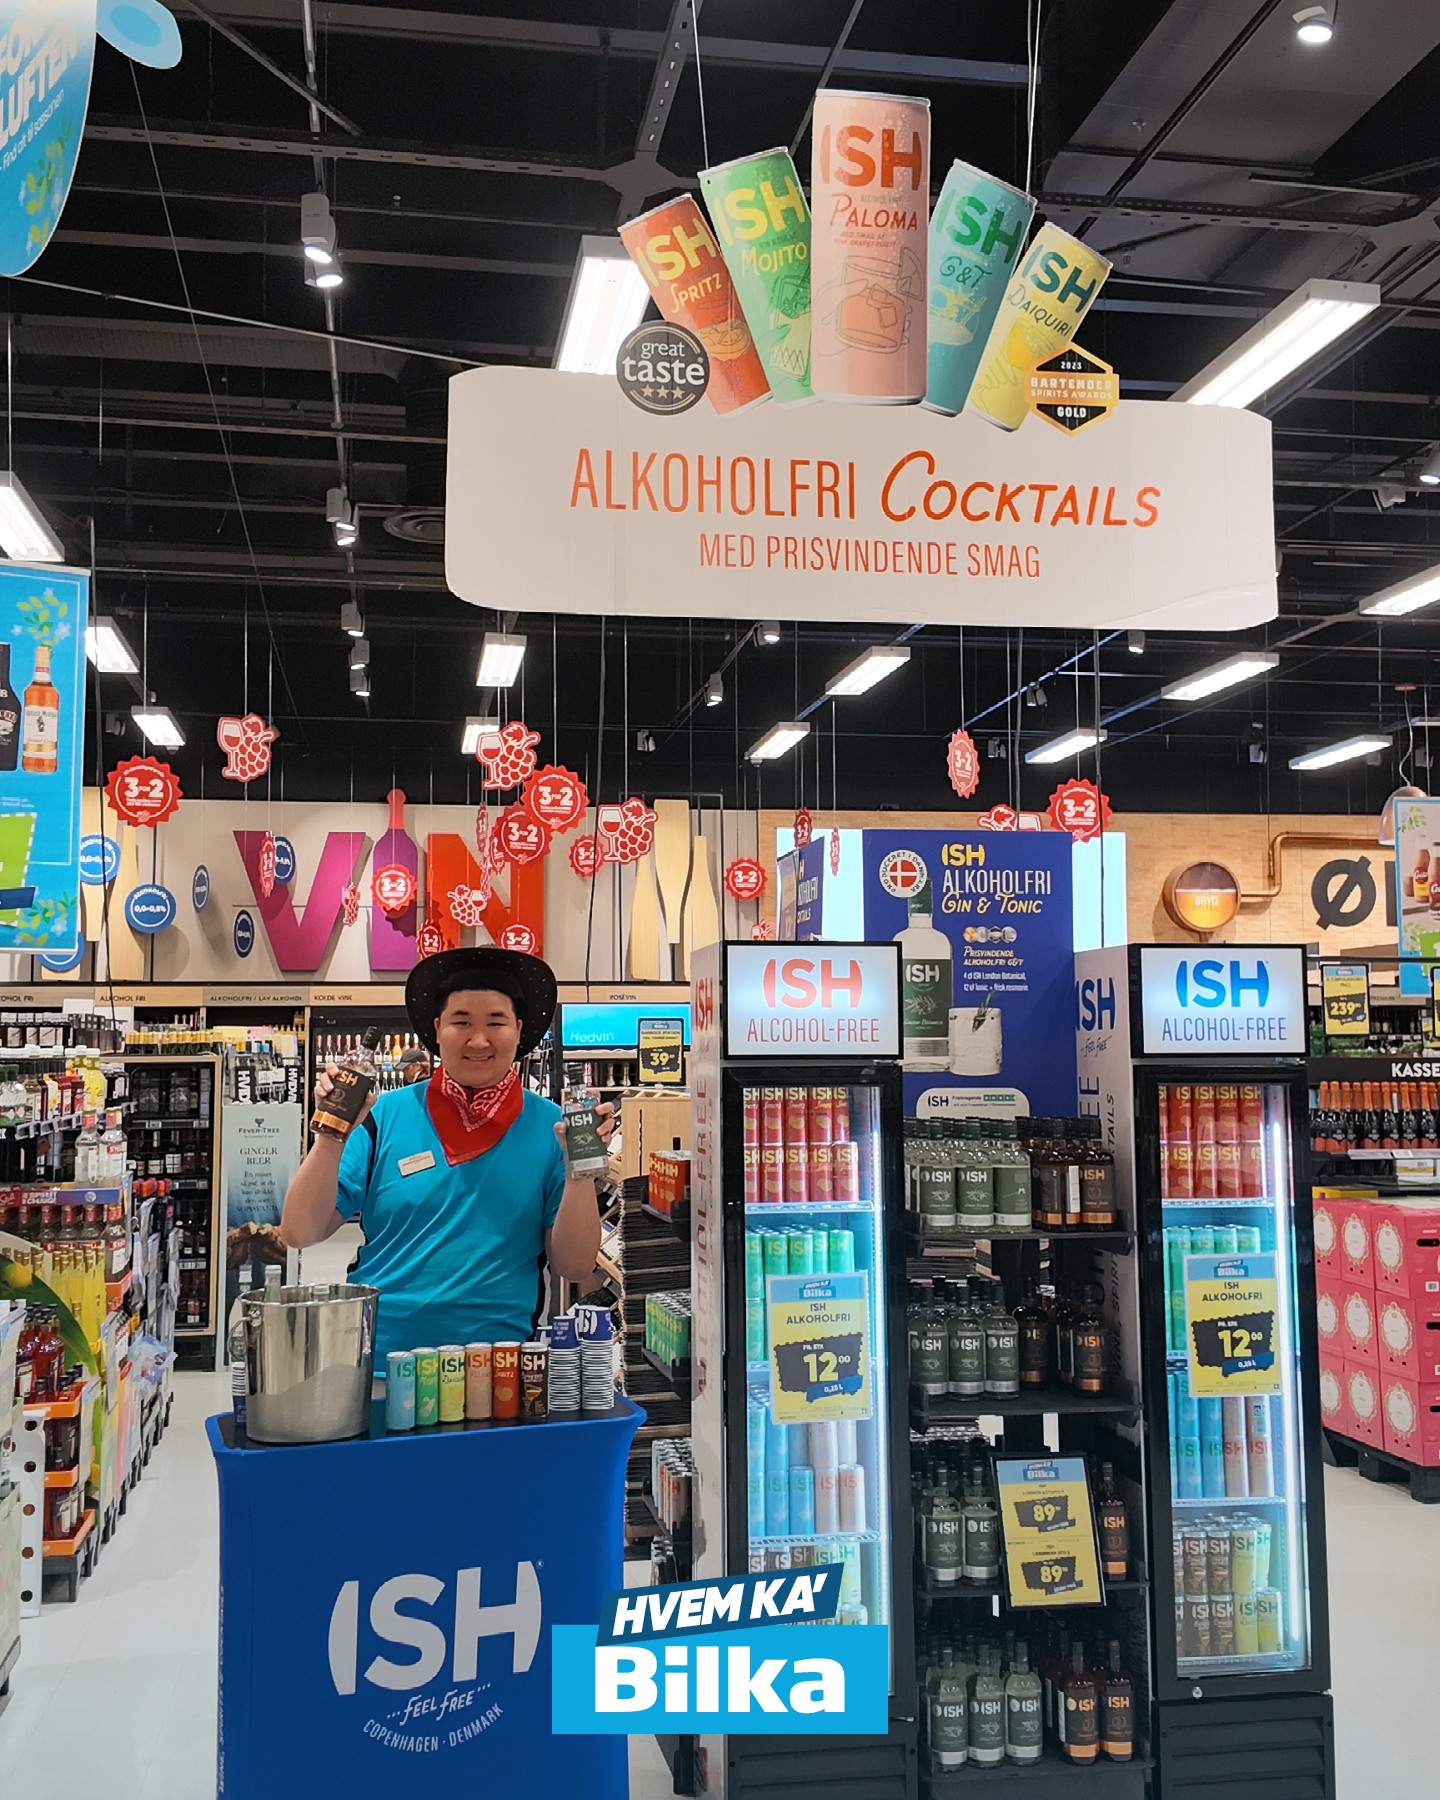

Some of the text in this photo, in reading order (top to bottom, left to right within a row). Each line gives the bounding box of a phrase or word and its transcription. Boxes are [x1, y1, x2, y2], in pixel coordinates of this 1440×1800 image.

[820, 125, 923, 190] ISH
[714, 175, 806, 246] ISH
[830, 193, 918, 230] PALOMA
[935, 189, 1023, 264] ISH
[636, 217, 716, 288] ISH
[741, 242, 807, 277] MOJITO
[939, 256, 993, 289] G&T
[1021, 244, 1099, 313] ISH
[670, 273, 722, 313] SPRITZ
[1006, 283, 1073, 337] DAIQUIRI
[641, 341, 685, 359] great
[622, 356, 705, 385] taste
[1060, 361, 1082, 370] 2023
[1030, 377, 1112, 390] BARTENDER
[1030, 388, 1112, 400] SPIRITS AWARDS
[1057, 406, 1087, 418] GOLD
[570, 448, 1162, 528] ALKOHOLFRI COCKTAILS
[699, 532, 1041, 578] MED PRISVINDENDE SMAG
[941, 843, 985, 867] ISH
[942, 869, 1051, 895] ALKOHOLFRI
[942, 890, 1043, 914] GIN & TONIC
[906, 964, 940, 983] ISH
[763, 958, 863, 1008] ISH
[1175, 960, 1270, 1008] ISH
[696, 977, 713, 1031] ISH
[1330, 1001, 1355, 1015] 239
[747, 1018, 880, 1043] ALCOHOL-FREE
[1161, 1017, 1287, 1041] ALCOHOL-FREE
[650, 1052, 670, 1066] 39
[927, 1095, 949, 1107] ISH
[571, 1113, 592, 1127] ISH
[239, 1147, 278, 1155] GINGER
[246, 1157, 271, 1165] BEER
[931, 1171, 951, 1183] ISH
[966, 1171, 987, 1183] ISH
[1084, 1169, 1105, 1181] ISH
[1202, 1292, 1262, 1302] ALKOHOLFRI
[810, 1303, 826, 1311] ISH
[786, 1313, 850, 1324] ALKOHOLFRI
[921, 1339, 942, 1351] ISH
[961, 1339, 980, 1351] ISH
[1084, 1335, 1104, 1347] ISH
[1218, 1329, 1252, 1358] 12
[493, 1352, 518, 1367] ISH
[521, 1354, 545, 1371] ISH
[803, 1351, 851, 1382] 12 00
[1224, 1441, 1243, 1455] SH
[1033, 1504, 1056, 1522] 89
[939, 1521, 958, 1535] ISH
[1104, 1516, 1125, 1530] ISH
[1210, 1540, 1230, 1553] SH
[1040, 1565, 1063, 1583] 89
[328, 1560, 543, 1696] ISH
[944, 1704, 964, 1718] ISH
[981, 1701, 1000, 1715] ISH
[1021, 1699, 1041, 1713] ISH
[1108, 1696, 1130, 1709] ISH
[363, 1703, 505, 1754] COPENHAGEN DENMARK
